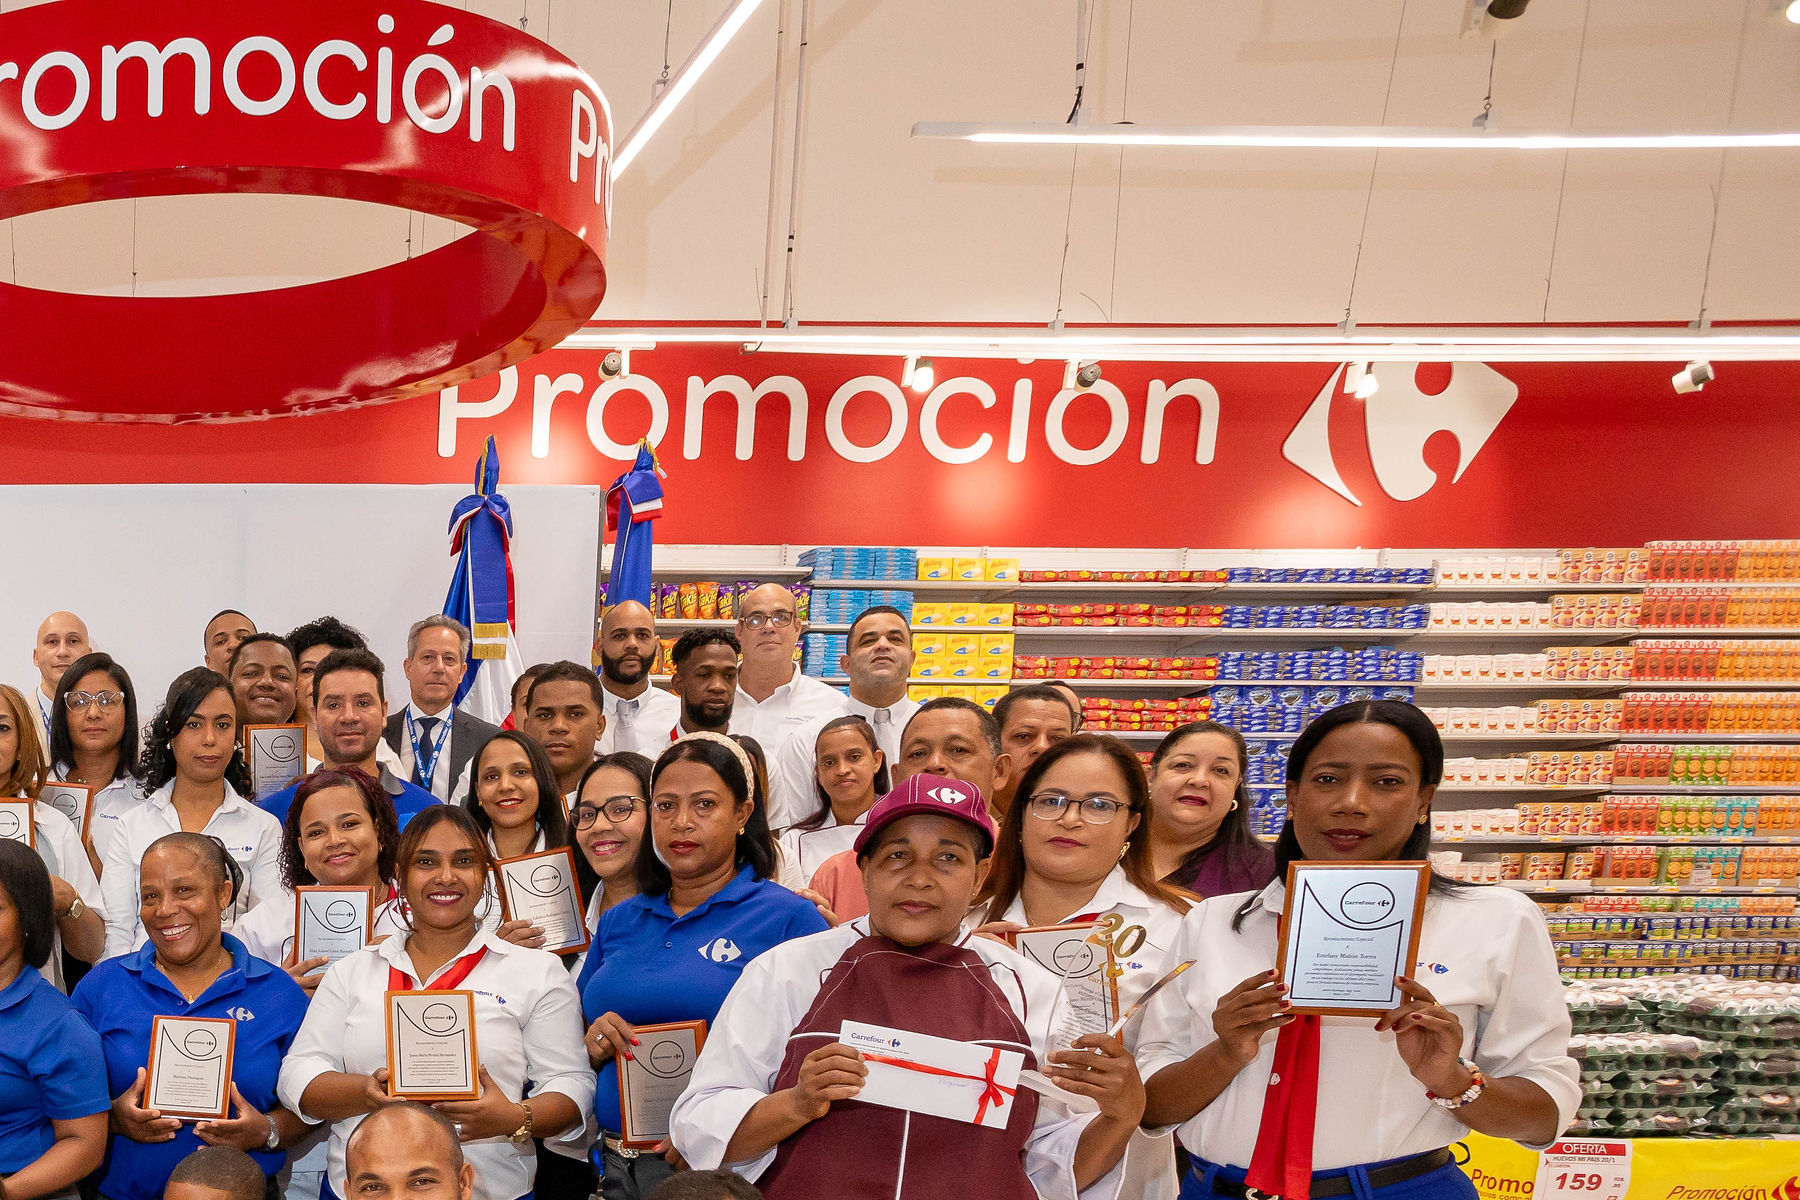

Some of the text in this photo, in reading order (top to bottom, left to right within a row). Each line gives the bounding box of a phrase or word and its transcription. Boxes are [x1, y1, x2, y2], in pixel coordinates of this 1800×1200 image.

[438, 357, 1220, 465] Promoción
[1086, 913, 1146, 958] 20
[851, 1032, 885, 1044] Carrefour
[1562, 1143, 1608, 1155] OFERTA
[1555, 1172, 1603, 1191] 159
[1666, 1185, 1767, 1200] Promoción
